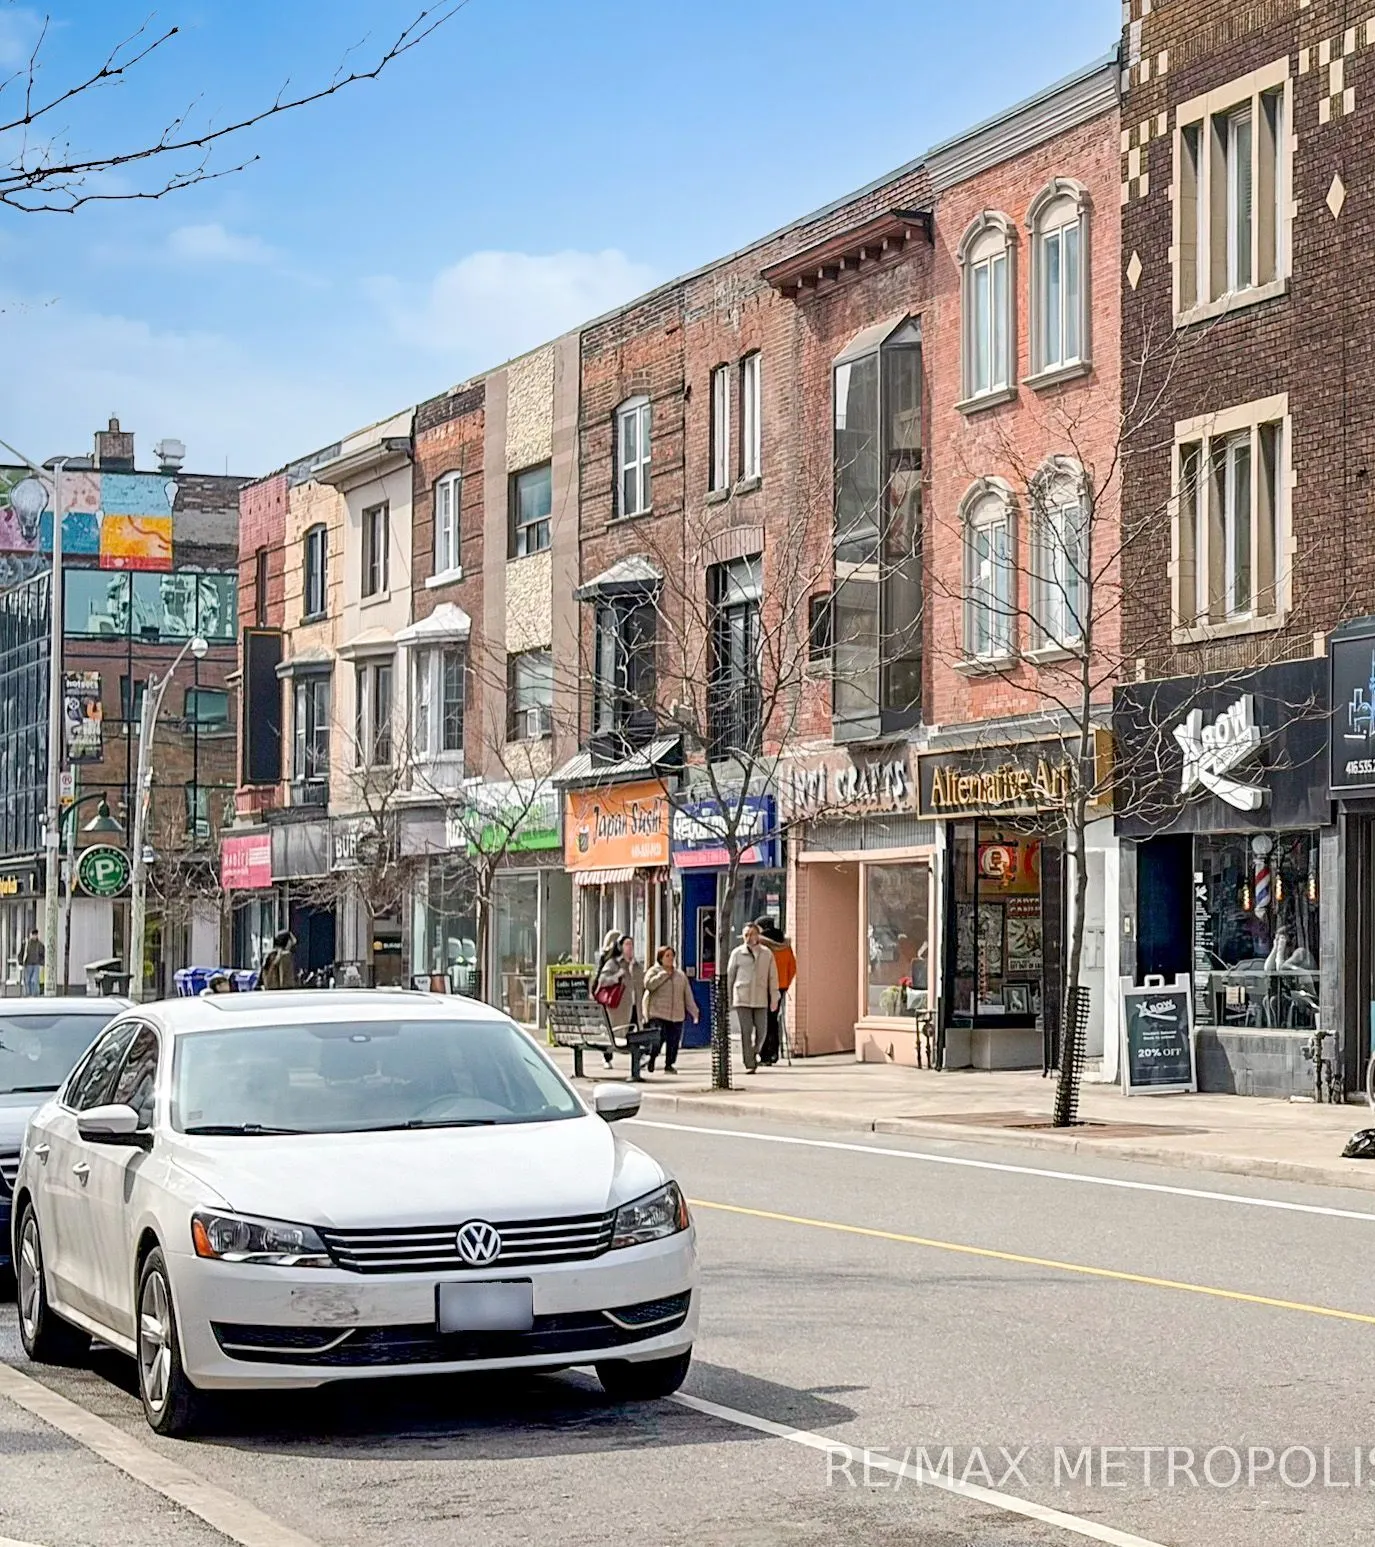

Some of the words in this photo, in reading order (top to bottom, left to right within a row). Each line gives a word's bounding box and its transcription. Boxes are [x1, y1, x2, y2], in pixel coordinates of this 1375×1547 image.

[834, 758, 906, 801] CRAFTS
[930, 760, 1029, 807] Alternative
[593, 805, 628, 845] Japan
[632, 798, 662, 835] Sushi
[1138, 1048, 1162, 1058] 20%
